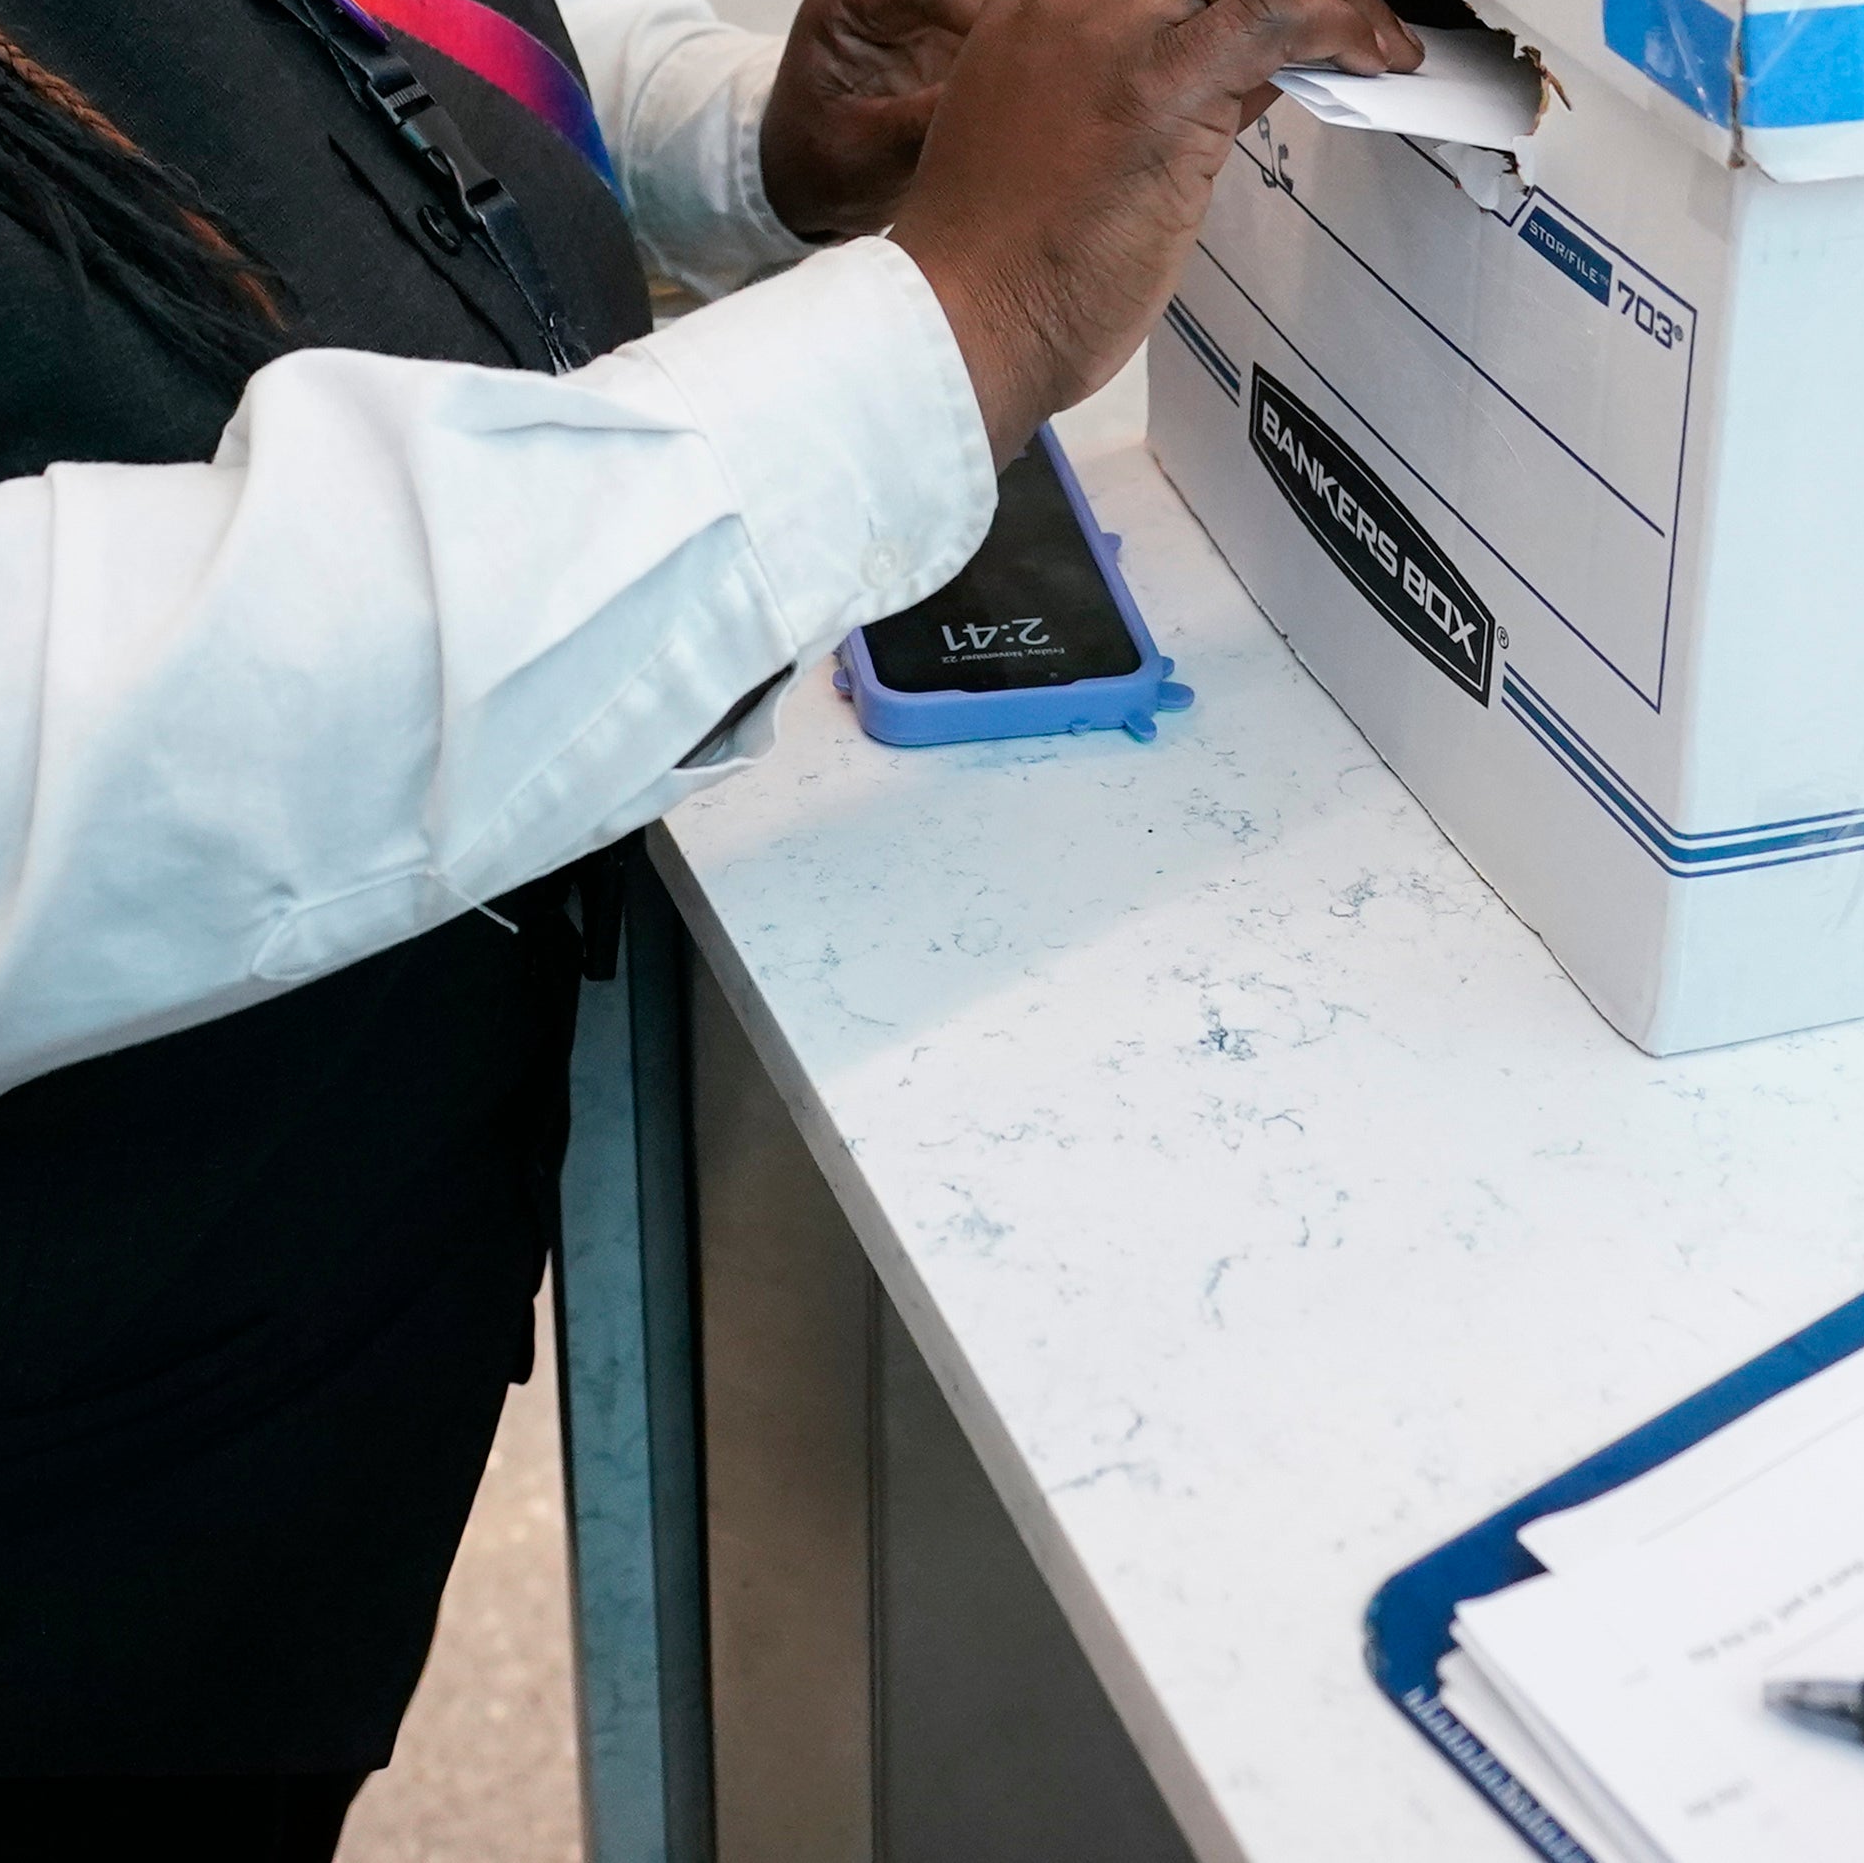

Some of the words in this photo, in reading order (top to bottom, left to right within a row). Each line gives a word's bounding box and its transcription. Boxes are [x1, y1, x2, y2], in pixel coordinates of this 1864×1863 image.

[1262, 400, 1398, 578] BANKERS
[1402, 556, 1477, 665] BOX
[941, 617, 1050, 651] 2:41
